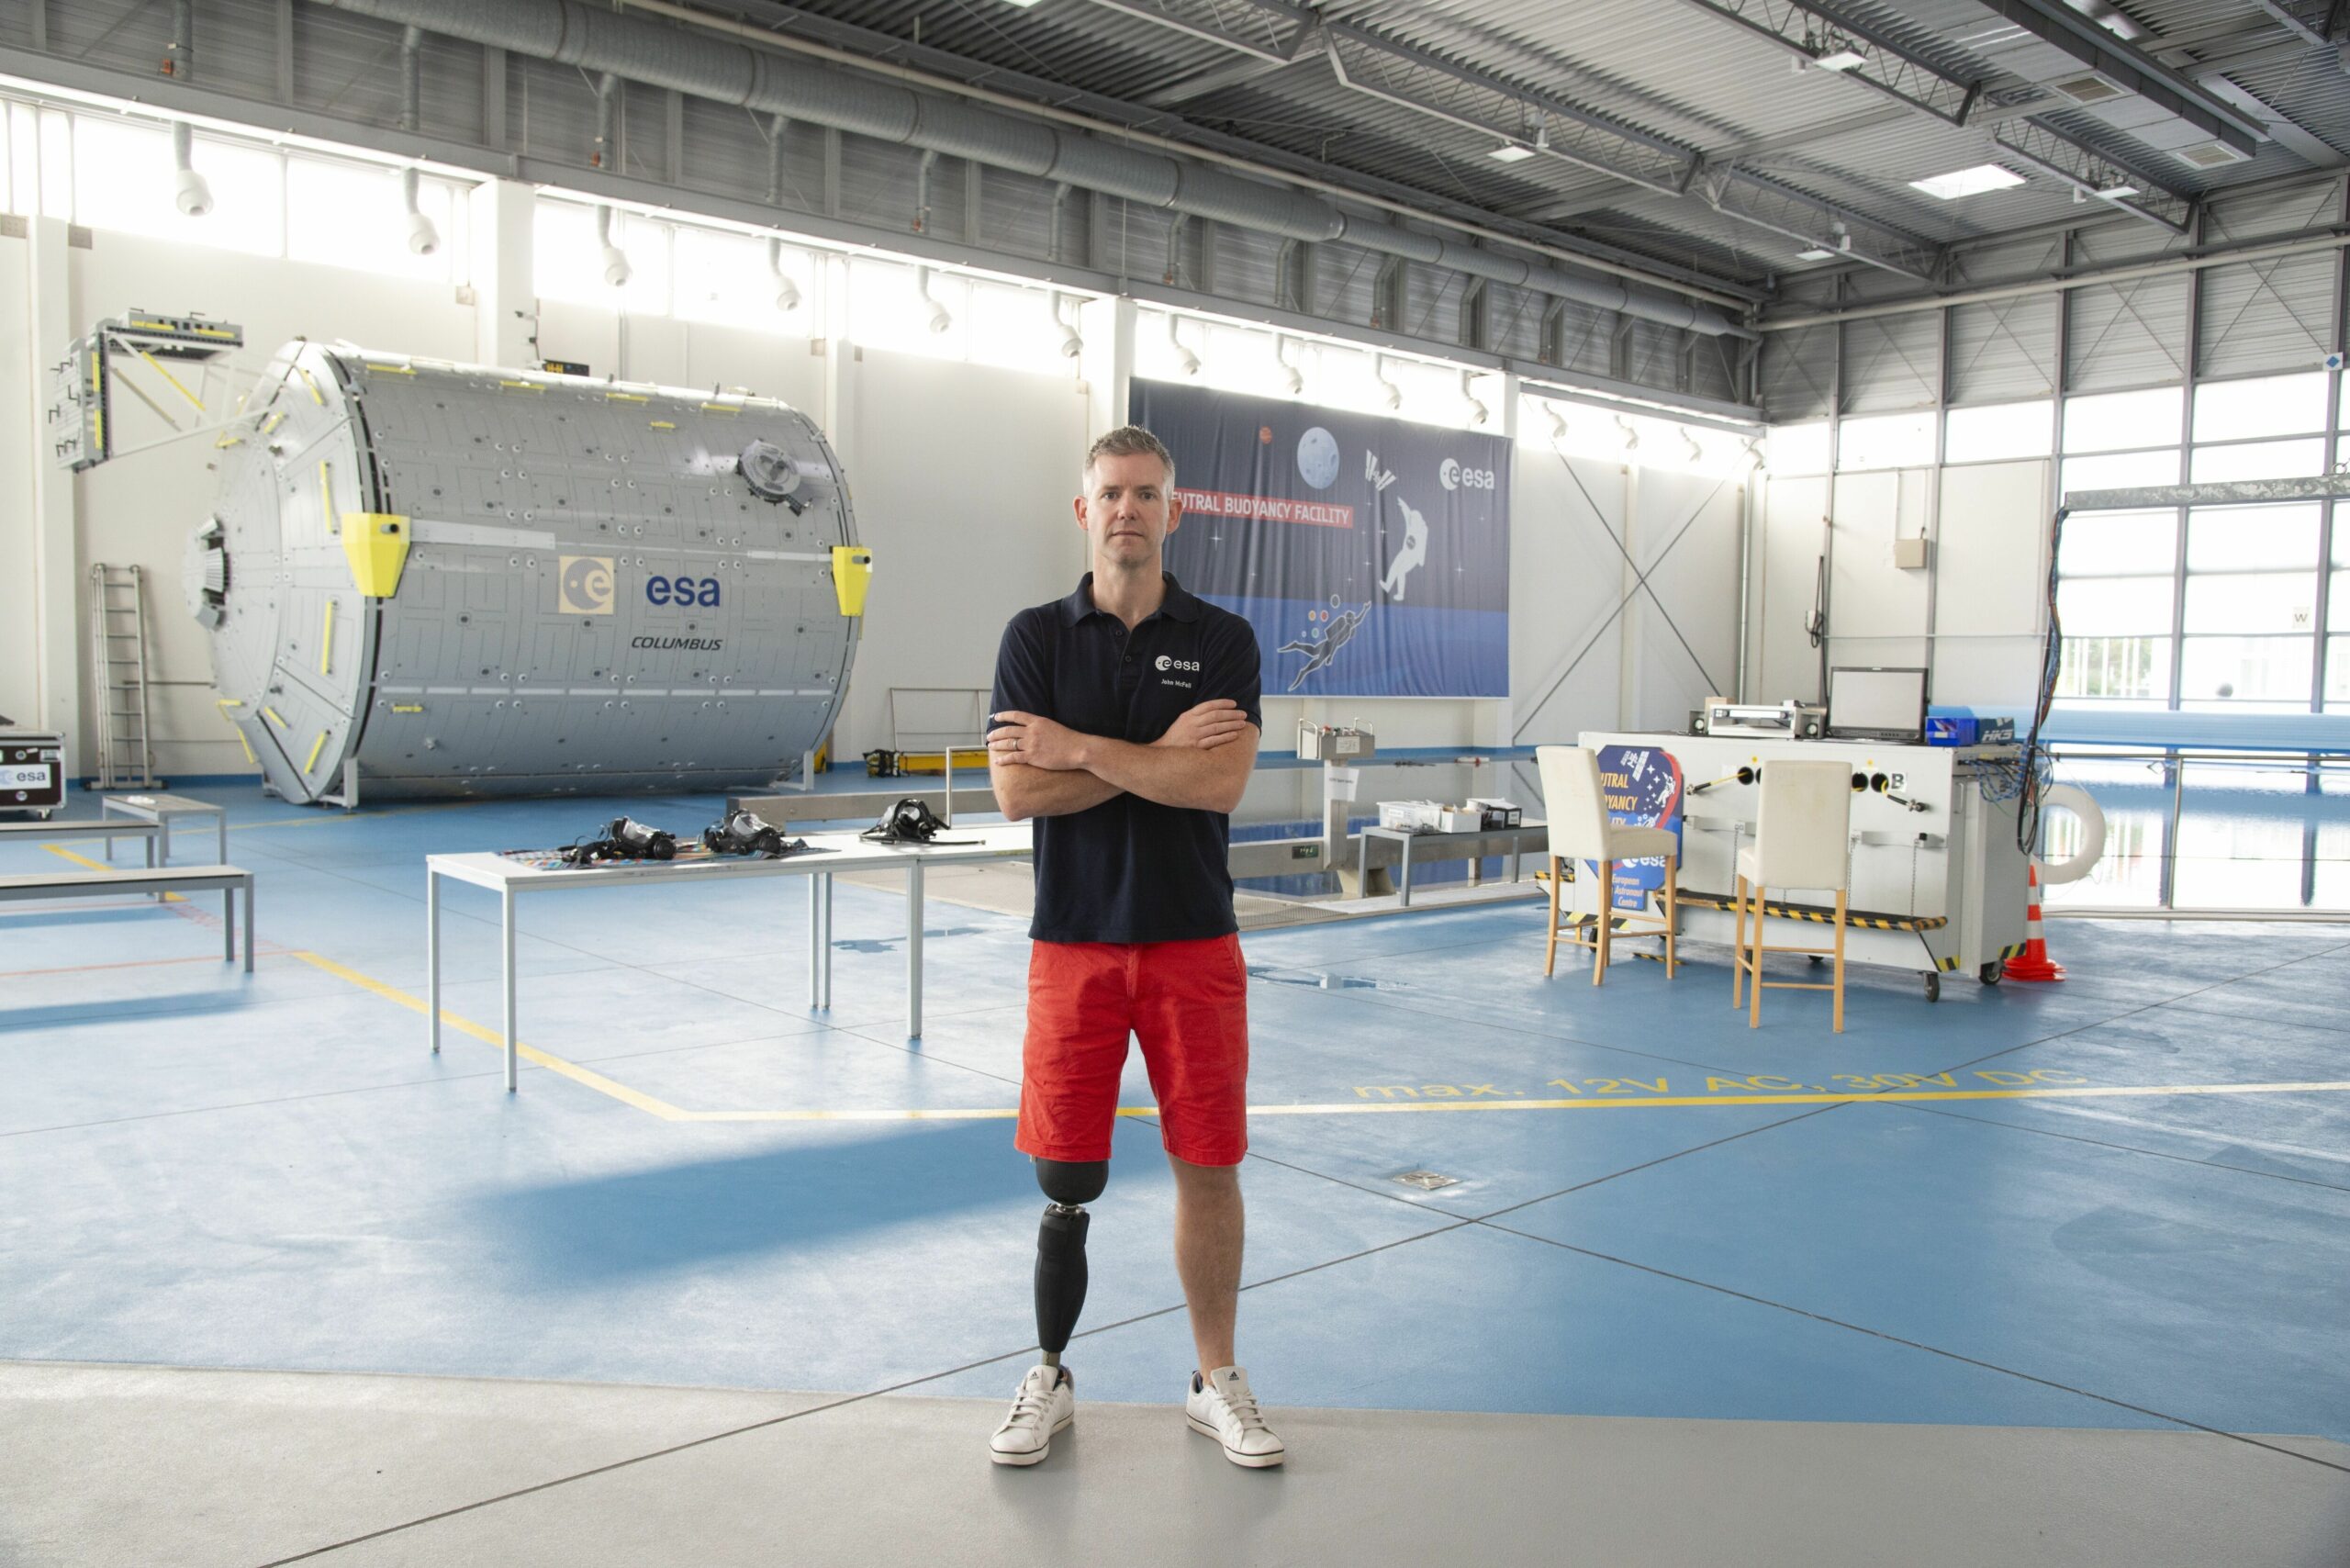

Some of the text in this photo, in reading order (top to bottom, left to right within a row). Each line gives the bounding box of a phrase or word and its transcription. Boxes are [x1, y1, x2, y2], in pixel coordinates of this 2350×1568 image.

[1462, 467, 1494, 489] esa
[1173, 491, 1349, 524] UTRAL BUOYANCY FACILITY
[645, 576, 721, 607] esa
[632, 636, 723, 651] COLUMBUS
[1173, 660, 1200, 671] esa
[17, 771, 46, 781] esa
[1891, 773, 1905, 790] B
[1350, 1083, 1524, 1099] max.
[1547, 1077, 1669, 1094] 12V
[1831, 1071, 1958, 1089] 30V
[1973, 1069, 2087, 1086] DC
